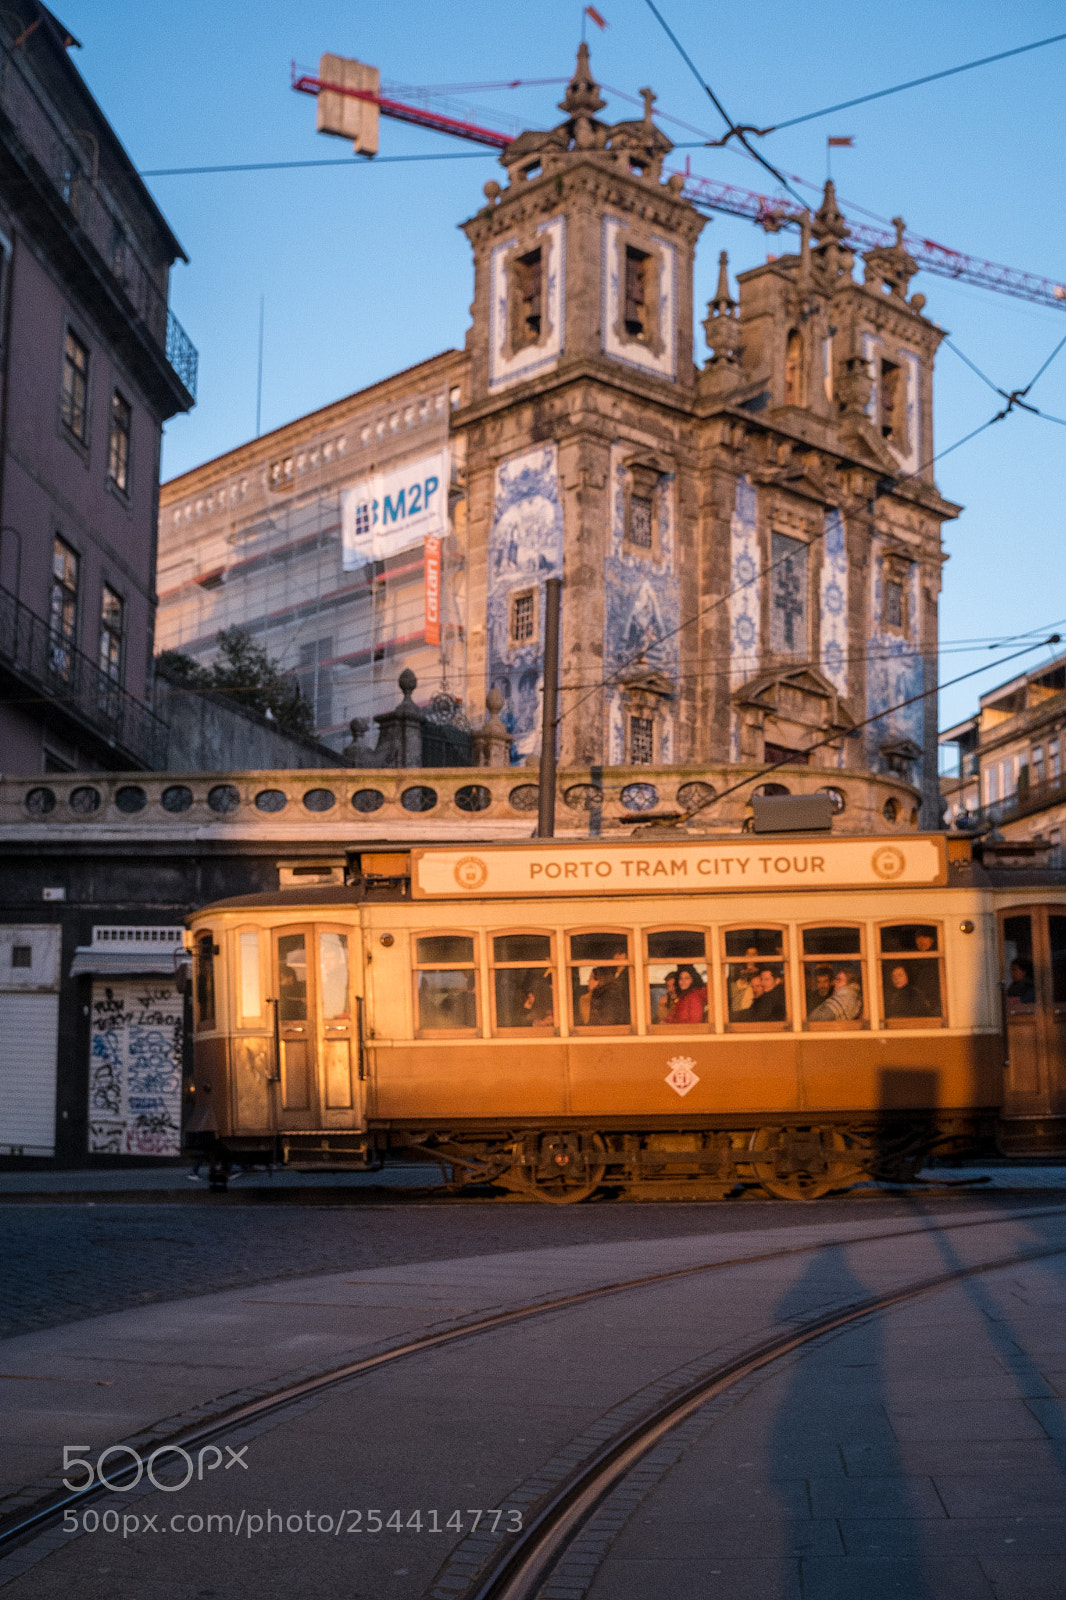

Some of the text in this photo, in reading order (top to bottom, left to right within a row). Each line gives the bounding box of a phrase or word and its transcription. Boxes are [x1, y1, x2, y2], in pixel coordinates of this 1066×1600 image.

[530, 856, 825, 879] PORTO TRAM CITY TOUR
